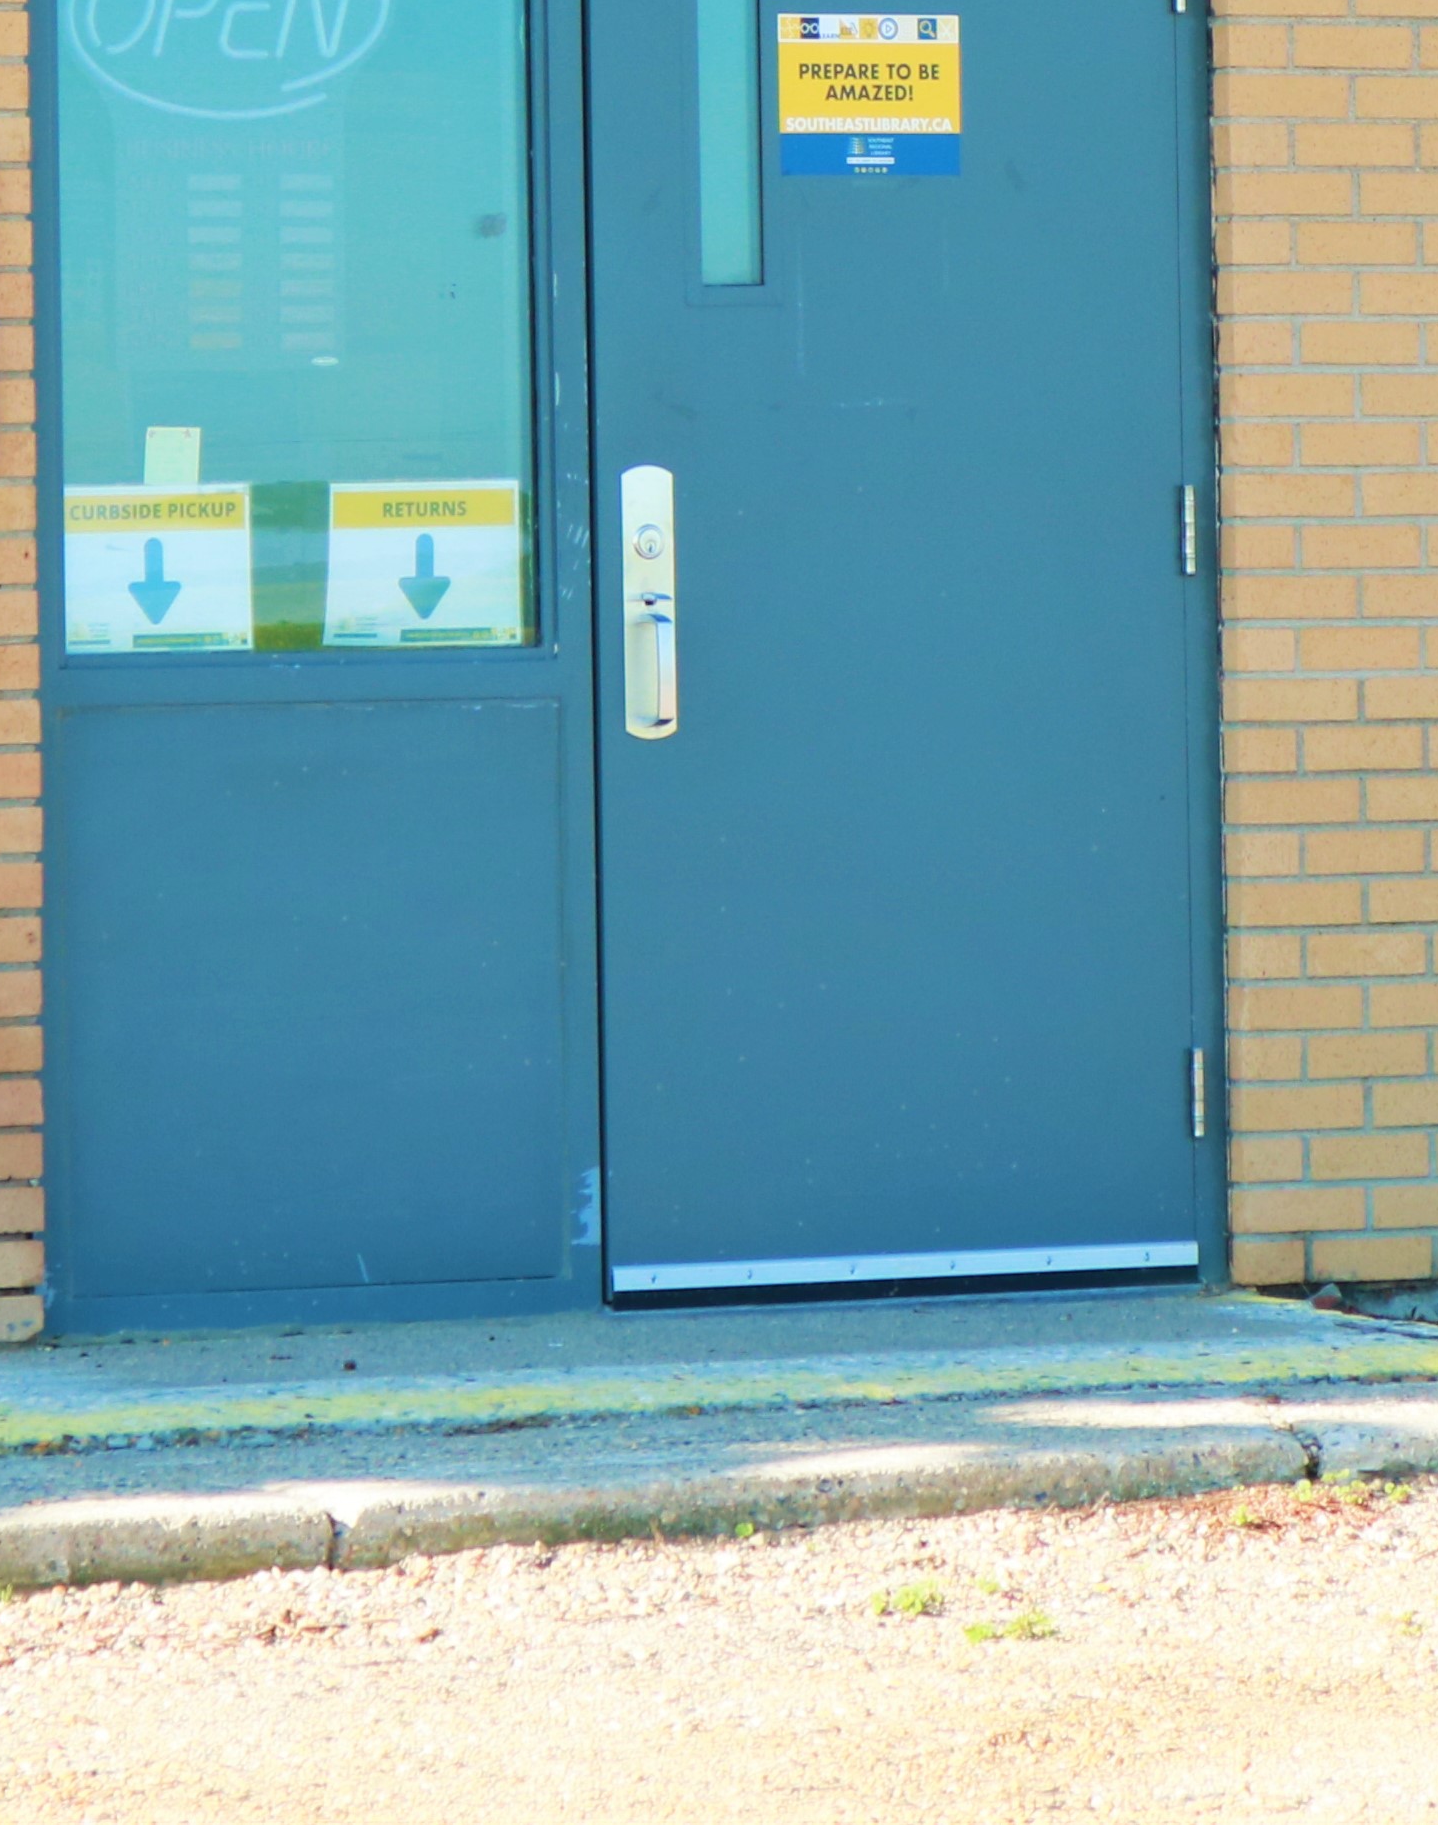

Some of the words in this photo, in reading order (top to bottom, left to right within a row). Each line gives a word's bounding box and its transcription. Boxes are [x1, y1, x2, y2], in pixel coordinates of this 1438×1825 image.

[799, 63, 879, 80] PREPARE
[886, 63, 912, 80] TO
[918, 63, 940, 81] BE
[825, 84, 913, 101] AMAZED!
[785, 117, 953, 132] SOUTHEASTLIBRARY.CA
[69, 502, 162, 521] CURBSIDE
[167, 501, 236, 519] PICKUP
[382, 500, 467, 518] RETURNS
